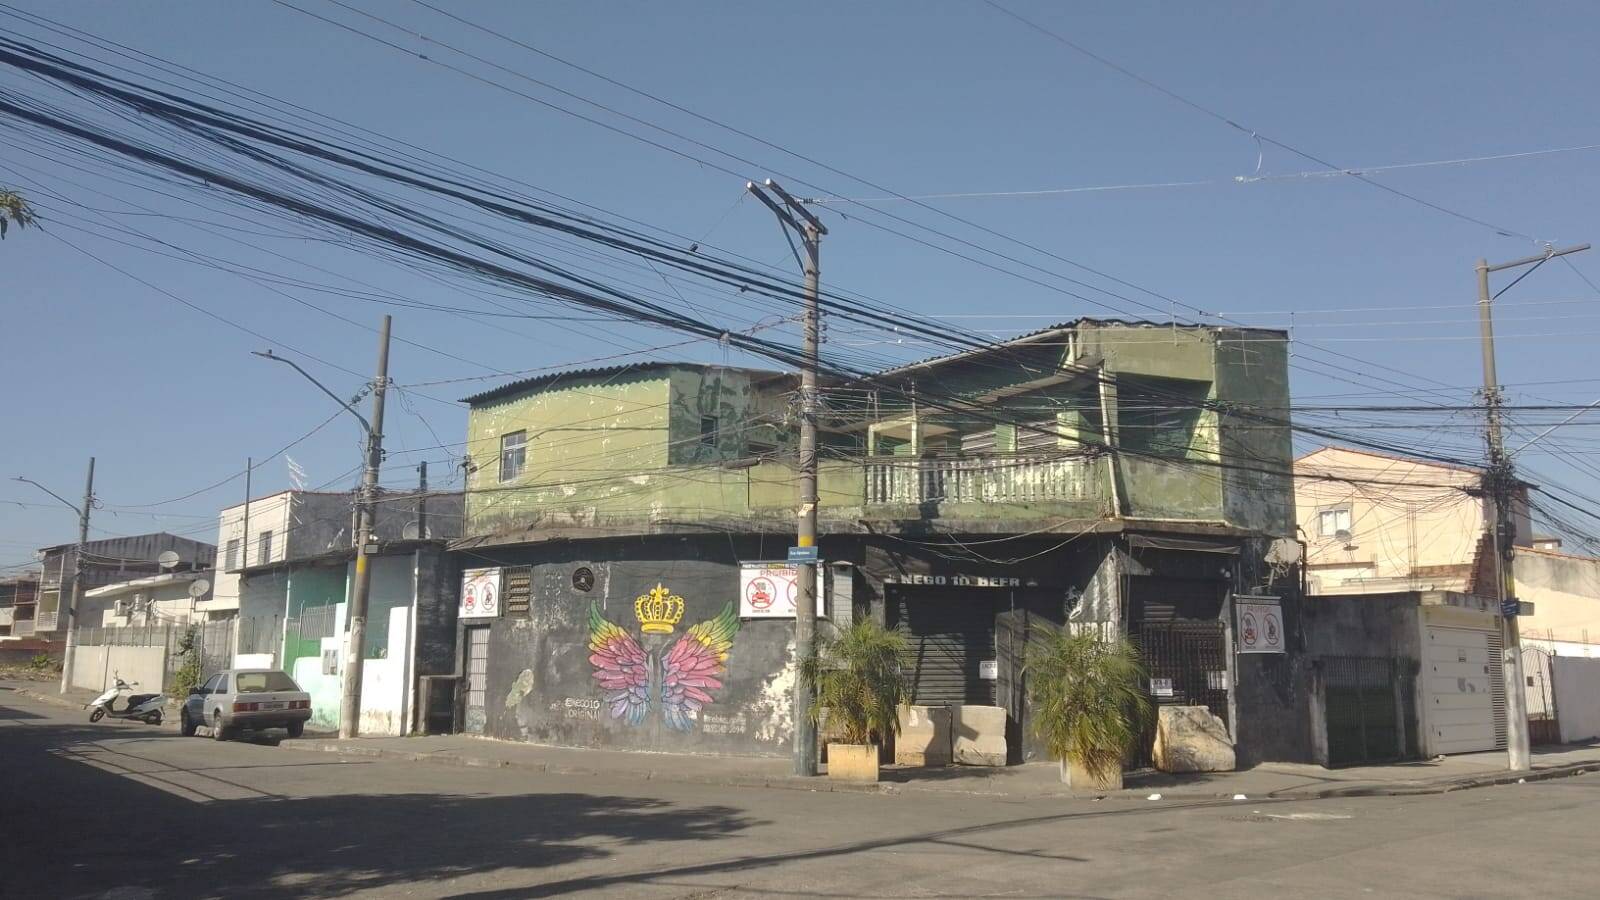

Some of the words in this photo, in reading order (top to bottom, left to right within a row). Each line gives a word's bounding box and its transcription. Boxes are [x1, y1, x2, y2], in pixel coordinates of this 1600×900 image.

[760, 569, 797, 577] PROIBID
[900, 574, 946, 585] NEGO
[977, 576, 1020, 587] BEER
